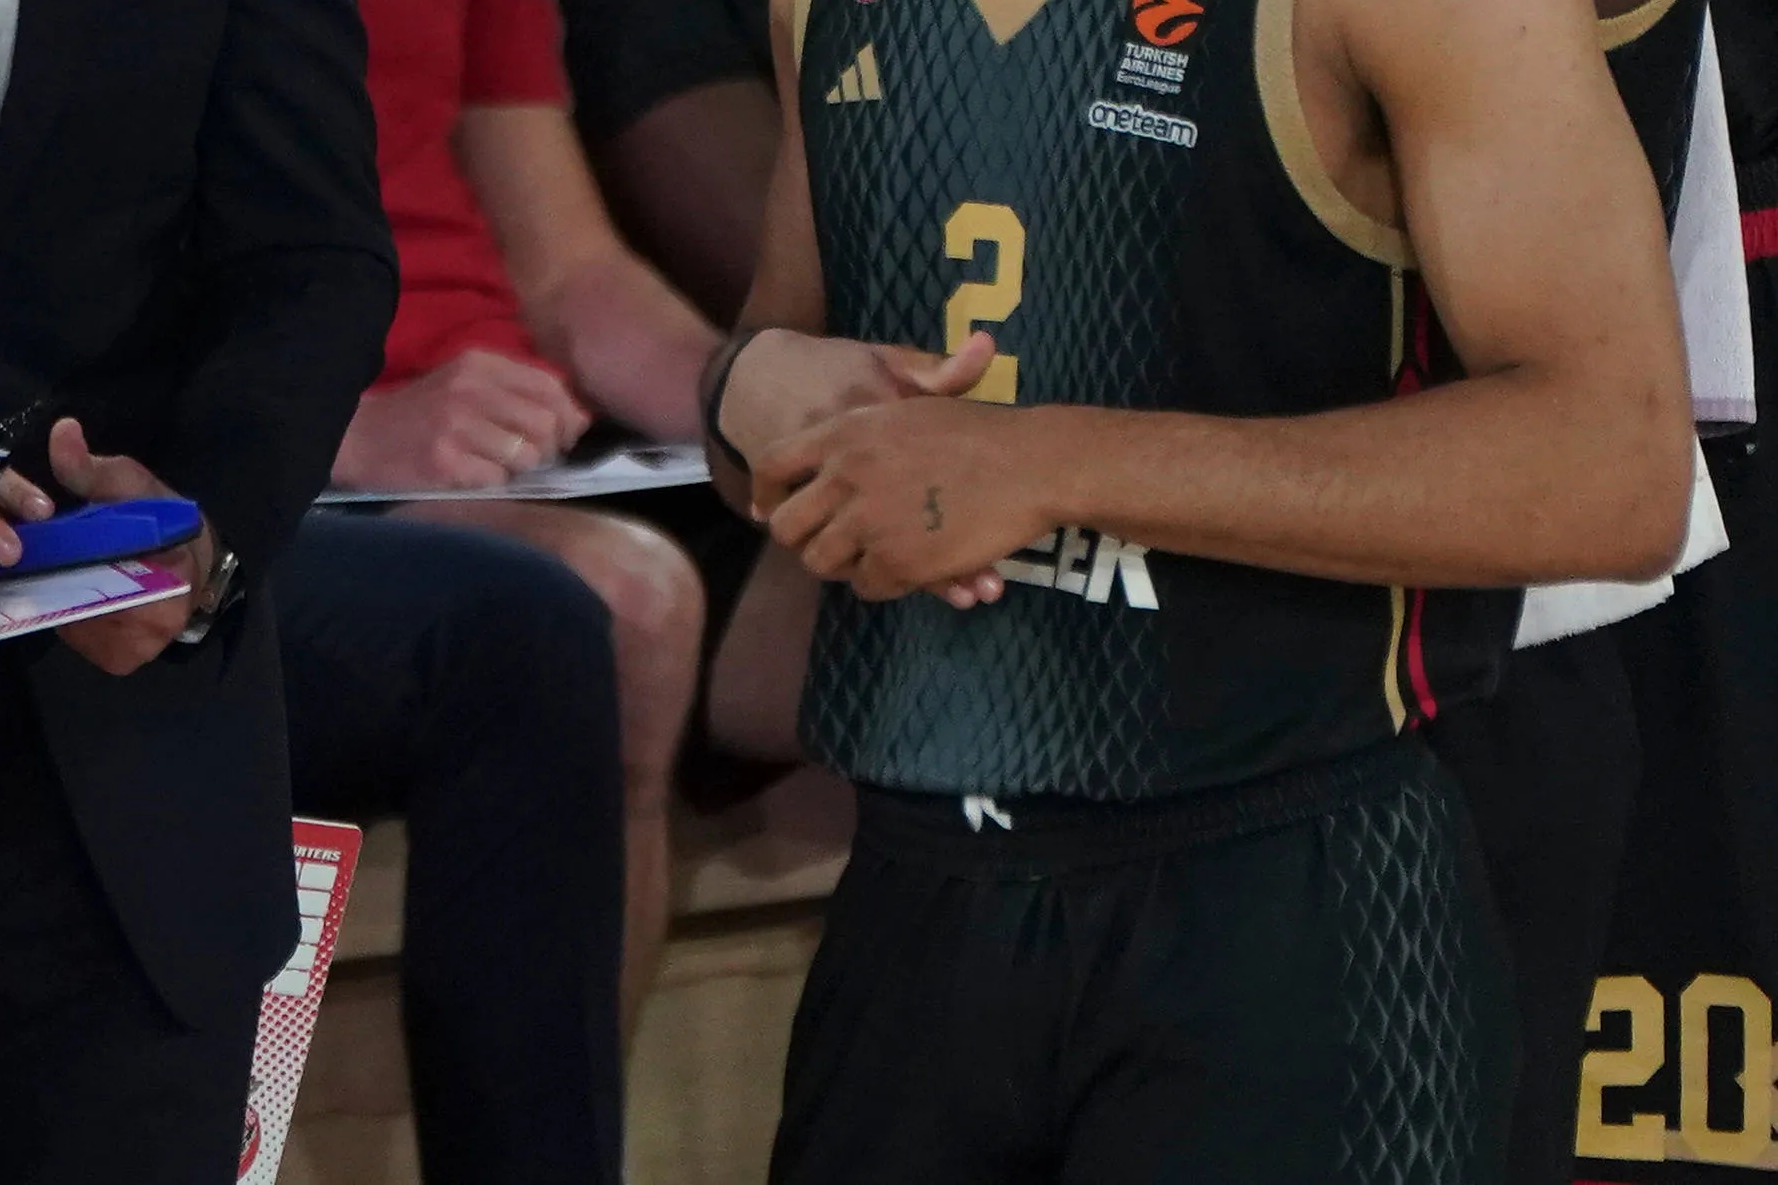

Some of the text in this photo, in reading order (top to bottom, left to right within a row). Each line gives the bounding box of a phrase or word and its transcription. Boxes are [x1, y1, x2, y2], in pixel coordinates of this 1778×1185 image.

[1120, 57, 1185, 82] AIRLINES
[1125, 42, 1190, 68] TURKISH
[1089, 102, 1198, 148] oneteam
[944, 202, 1026, 405] 2
[1574, 972, 1772, 1162] 20
